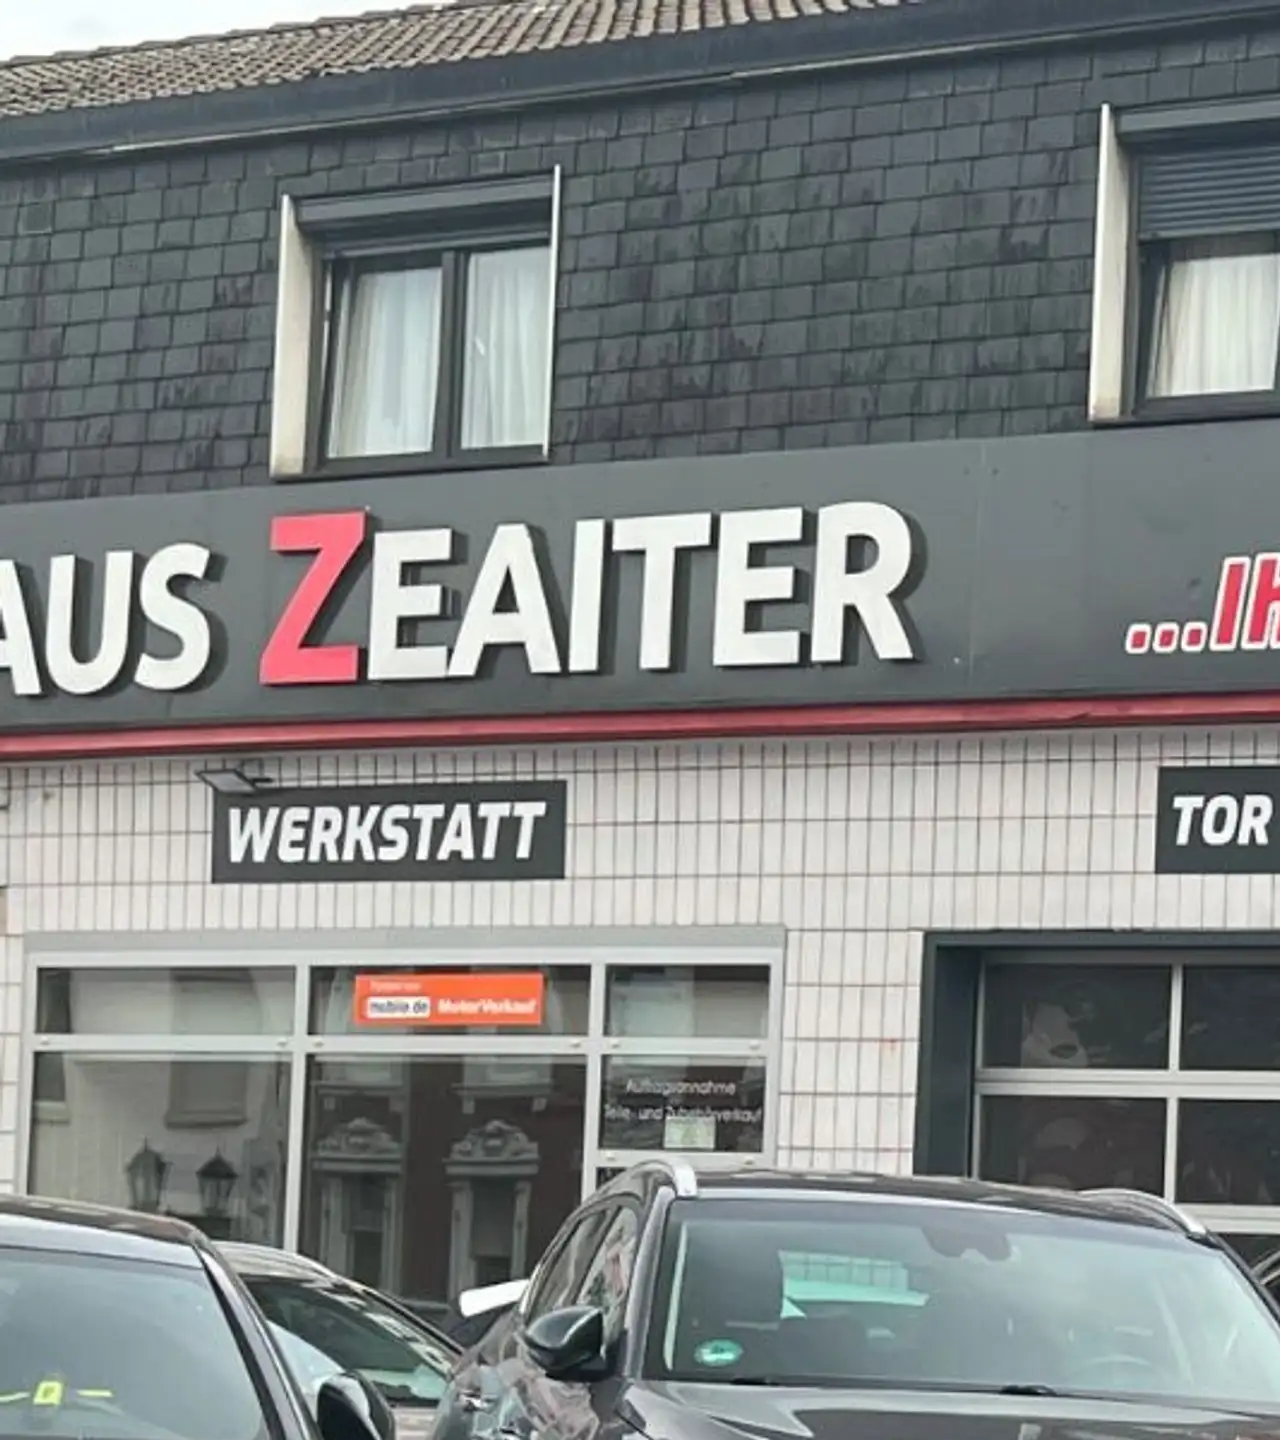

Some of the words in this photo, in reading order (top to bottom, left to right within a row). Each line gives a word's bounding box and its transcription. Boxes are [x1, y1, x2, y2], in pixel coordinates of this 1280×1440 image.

[260, 502, 914, 685] ZEAITER
[227, 800, 547, 863] WERKSTATT
[1171, 794, 1271, 846] TOR
